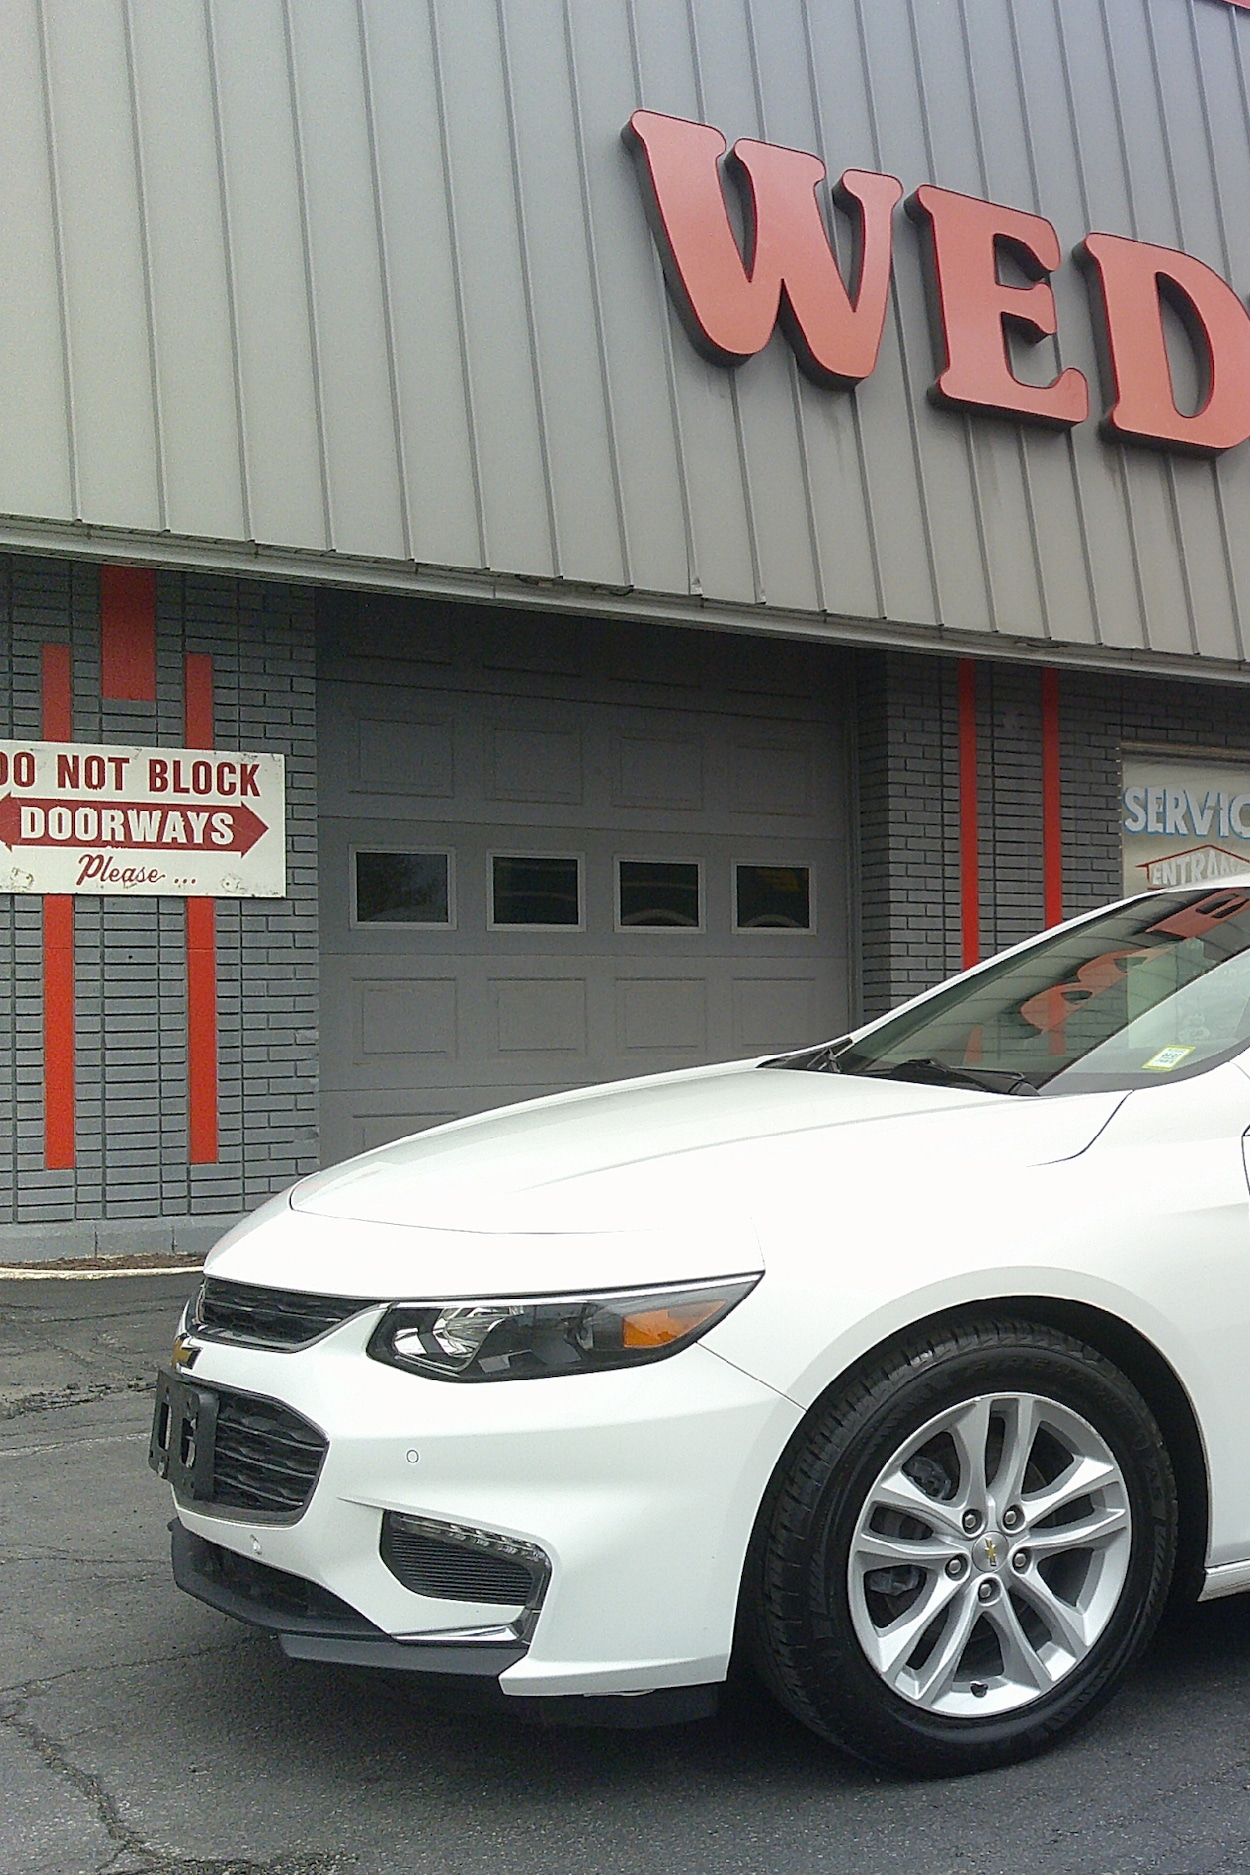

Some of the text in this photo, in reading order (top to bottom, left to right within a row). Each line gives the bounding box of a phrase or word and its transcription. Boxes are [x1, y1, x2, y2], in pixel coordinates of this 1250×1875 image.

[57, 754, 131, 791] NOT
[149, 758, 262, 797] BLOCK
[20, 805, 235, 846] DOORWAYS
[76, 853, 166, 886] Please
